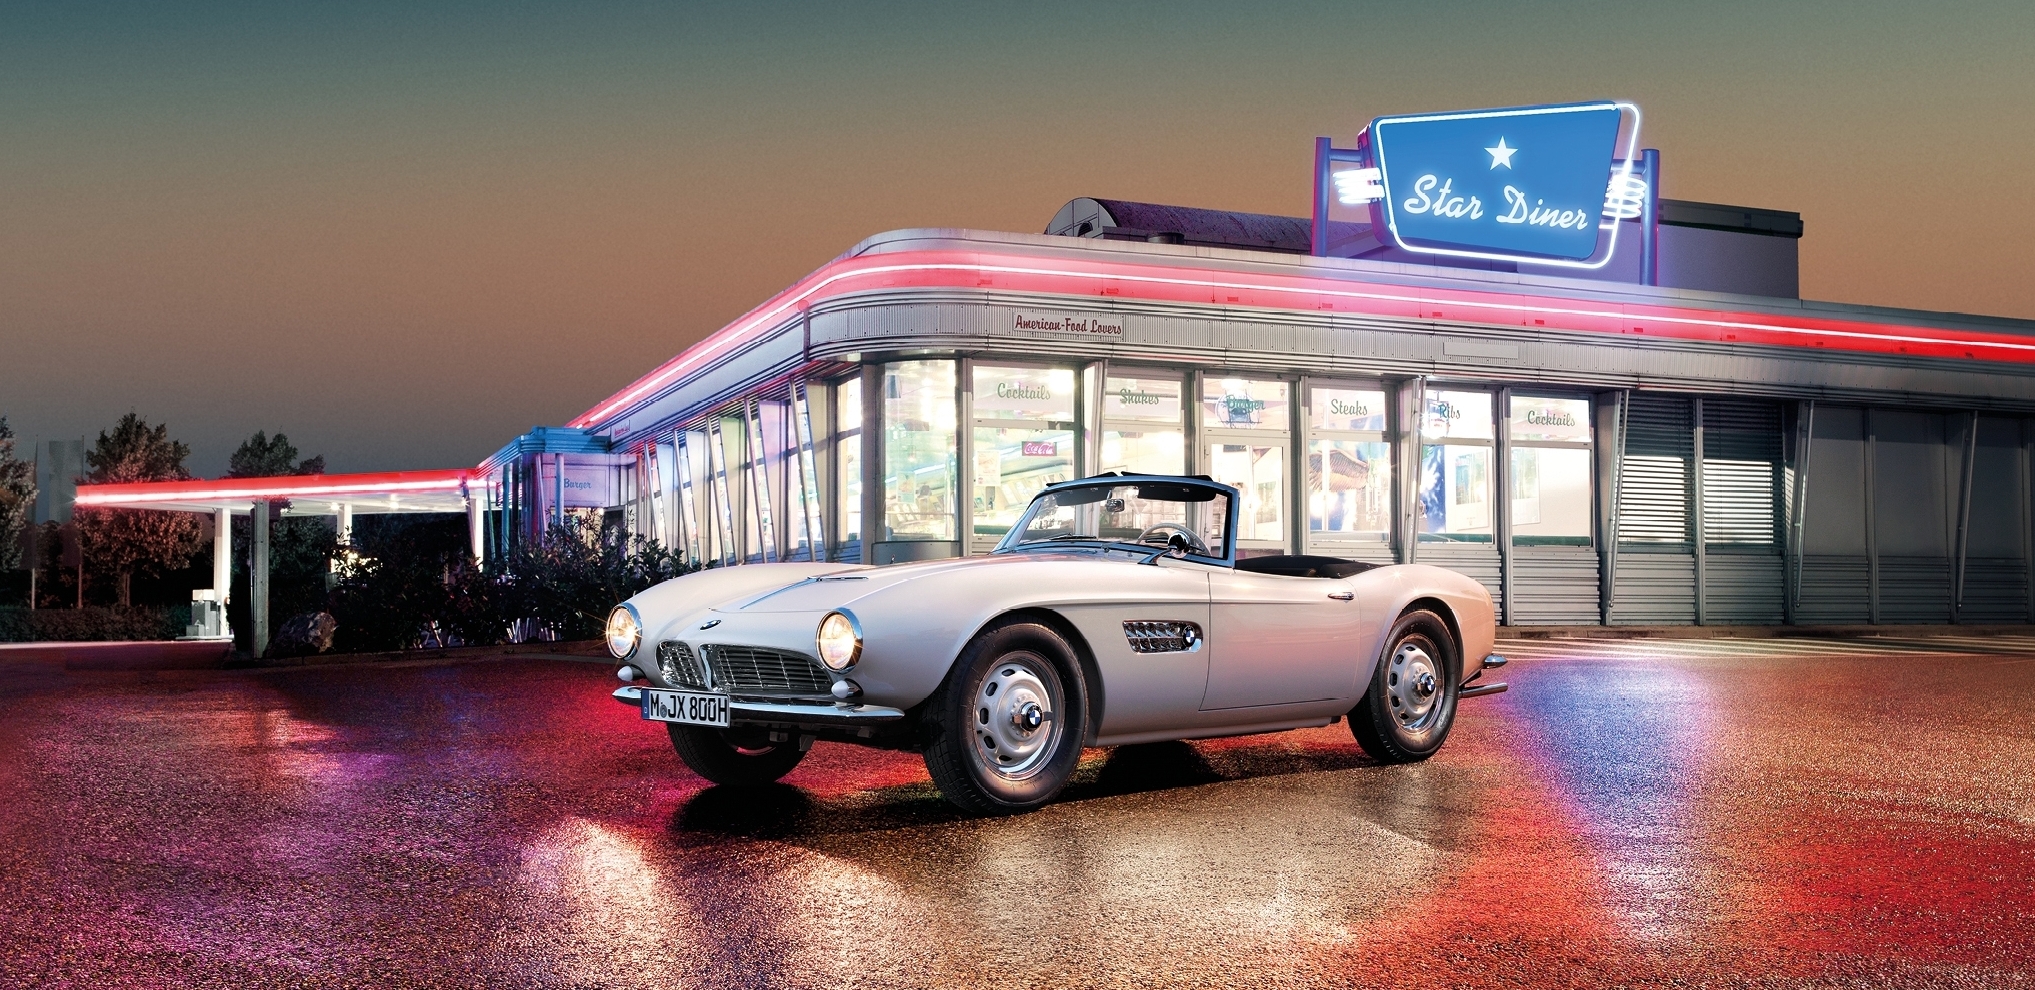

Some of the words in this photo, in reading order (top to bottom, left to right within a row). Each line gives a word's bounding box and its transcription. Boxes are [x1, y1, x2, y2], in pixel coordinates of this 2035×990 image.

[1403, 174, 1484, 220] Star
[1495, 184, 1588, 231] Diner
[1014, 314, 1088, 332] American-Food
[1090, 319, 1122, 335] Lovers
[997, 382, 1051, 401] Cocktails
[1119, 388, 1160, 405] Shakes
[1330, 398, 1368, 416] Steaks
[1438, 403, 1461, 419] Ribs
[1527, 410, 1576, 427] Cocktails
[563, 478, 592, 491] Burger
[689, 696, 728, 723] 800H
